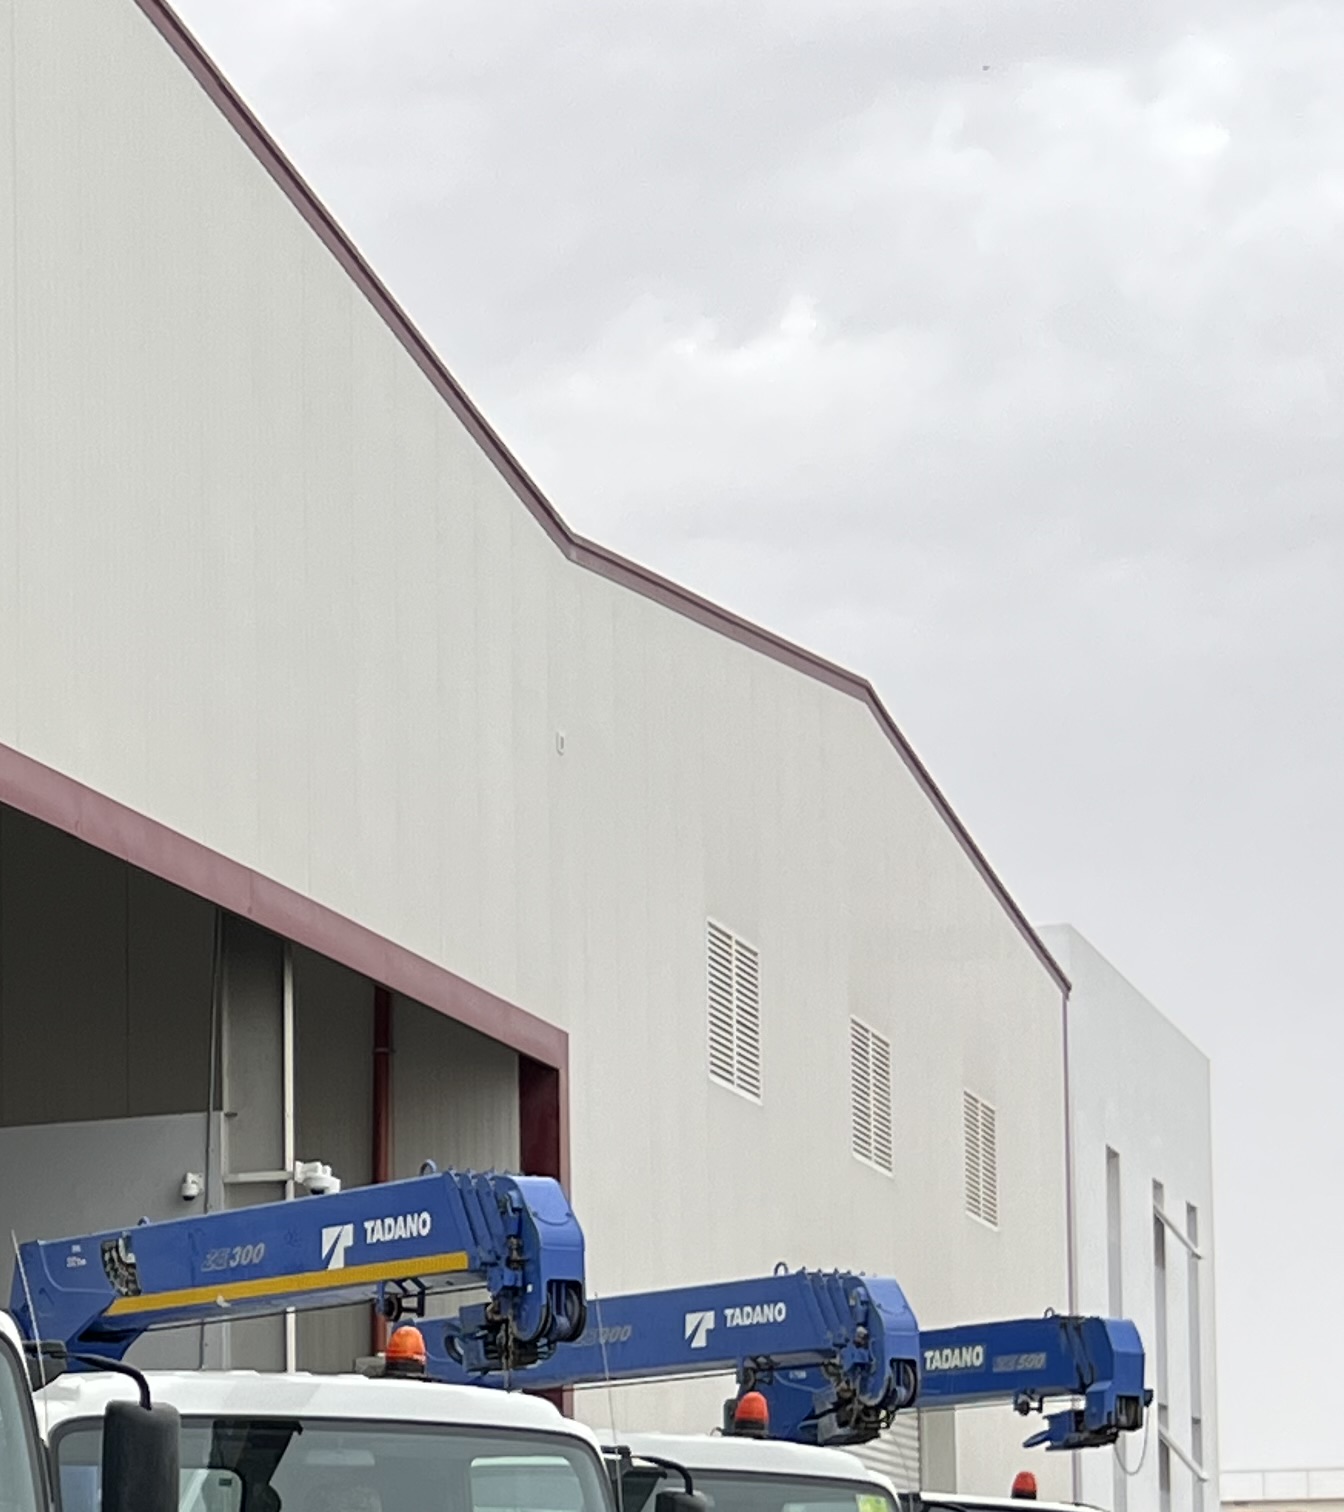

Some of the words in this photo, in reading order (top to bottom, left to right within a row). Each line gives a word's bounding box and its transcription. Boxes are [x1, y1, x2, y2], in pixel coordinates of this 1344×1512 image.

[363, 1211, 431, 1244] TADANO
[724, 1302, 787, 1328] TADANO
[924, 1345, 984, 1371] TADANO
